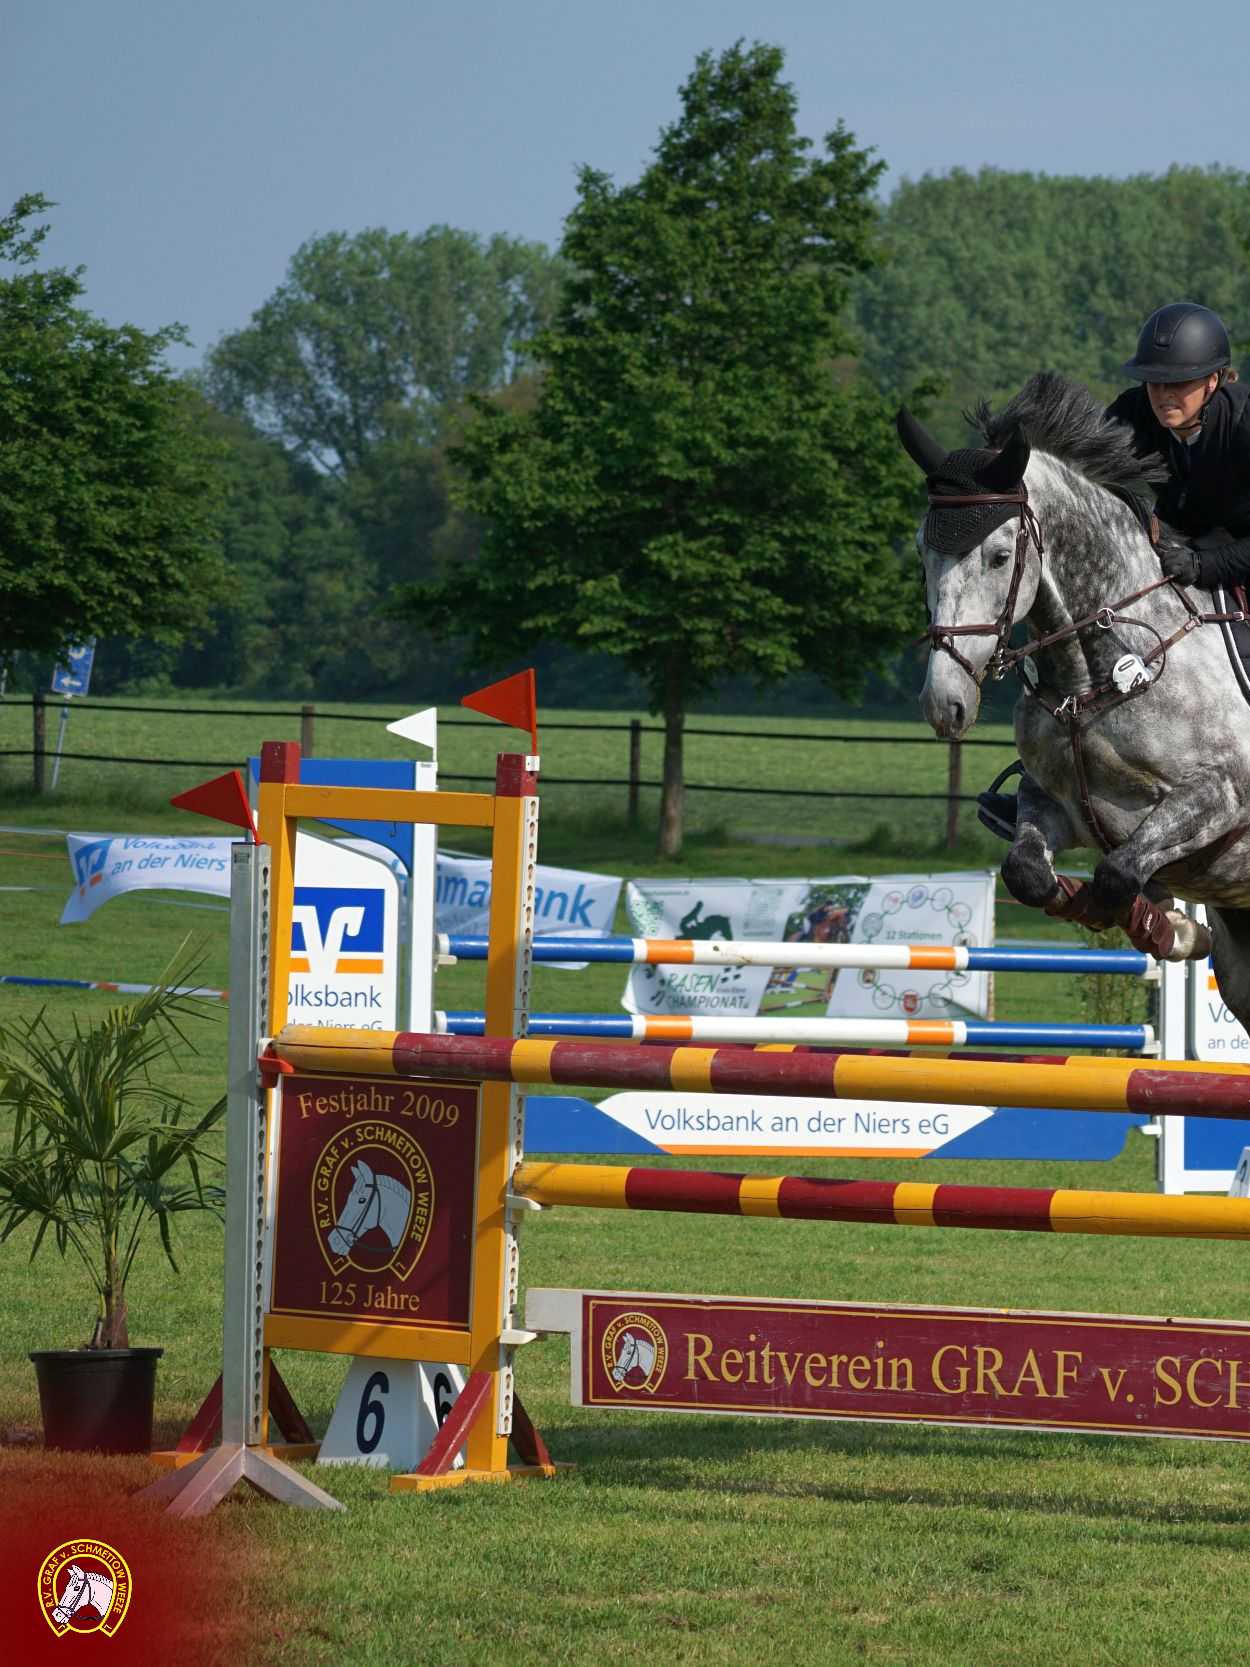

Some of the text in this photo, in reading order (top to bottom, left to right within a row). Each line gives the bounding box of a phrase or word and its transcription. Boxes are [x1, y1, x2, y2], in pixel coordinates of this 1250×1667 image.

[112, 854, 227, 876] an der Niers
[287, 984, 383, 1009] lksbank
[1207, 1038, 1226, 1049] an
[297, 1085, 460, 1128] Festjahr 2009
[645, 1109, 950, 1135] Volksbank an der Niers eG
[317, 1147, 340, 1190] GRAF
[355, 1126, 429, 1185] SCHMETTOW
[410, 1191, 430, 1243] WEEZE
[319, 1280, 420, 1311] 125 Jahre
[682, 1333, 914, 1392] Reitverein
[931, 1344, 1082, 1399] GRAF
[1099, 1367, 1134, 1404] v.
[356, 1371, 390, 1454] 6
